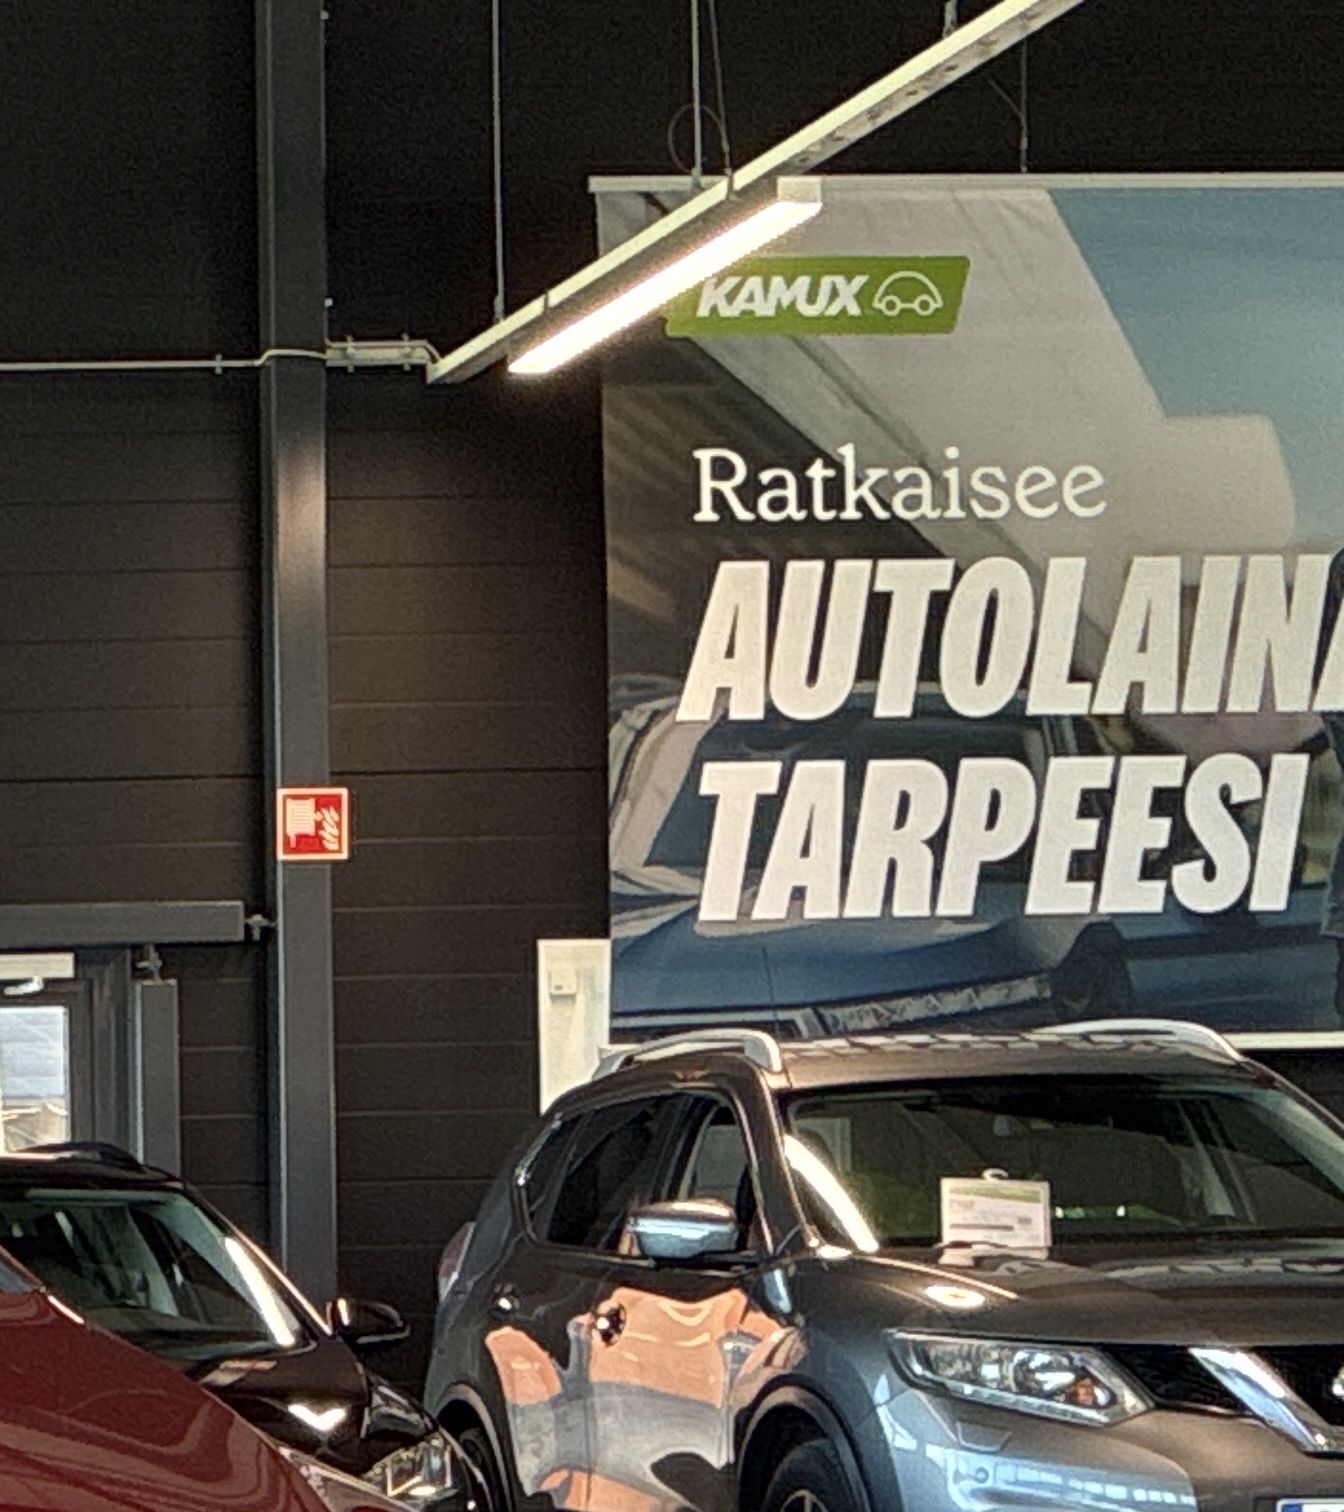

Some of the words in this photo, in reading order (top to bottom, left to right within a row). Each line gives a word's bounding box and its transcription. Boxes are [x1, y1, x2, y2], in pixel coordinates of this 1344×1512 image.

[696, 274, 869, 318] KAMUX
[692, 443, 1107, 522] Ratkaisee
[675, 553, 1344, 722] AUTOLAIN
[697, 752, 1310, 922] TARPEESI
